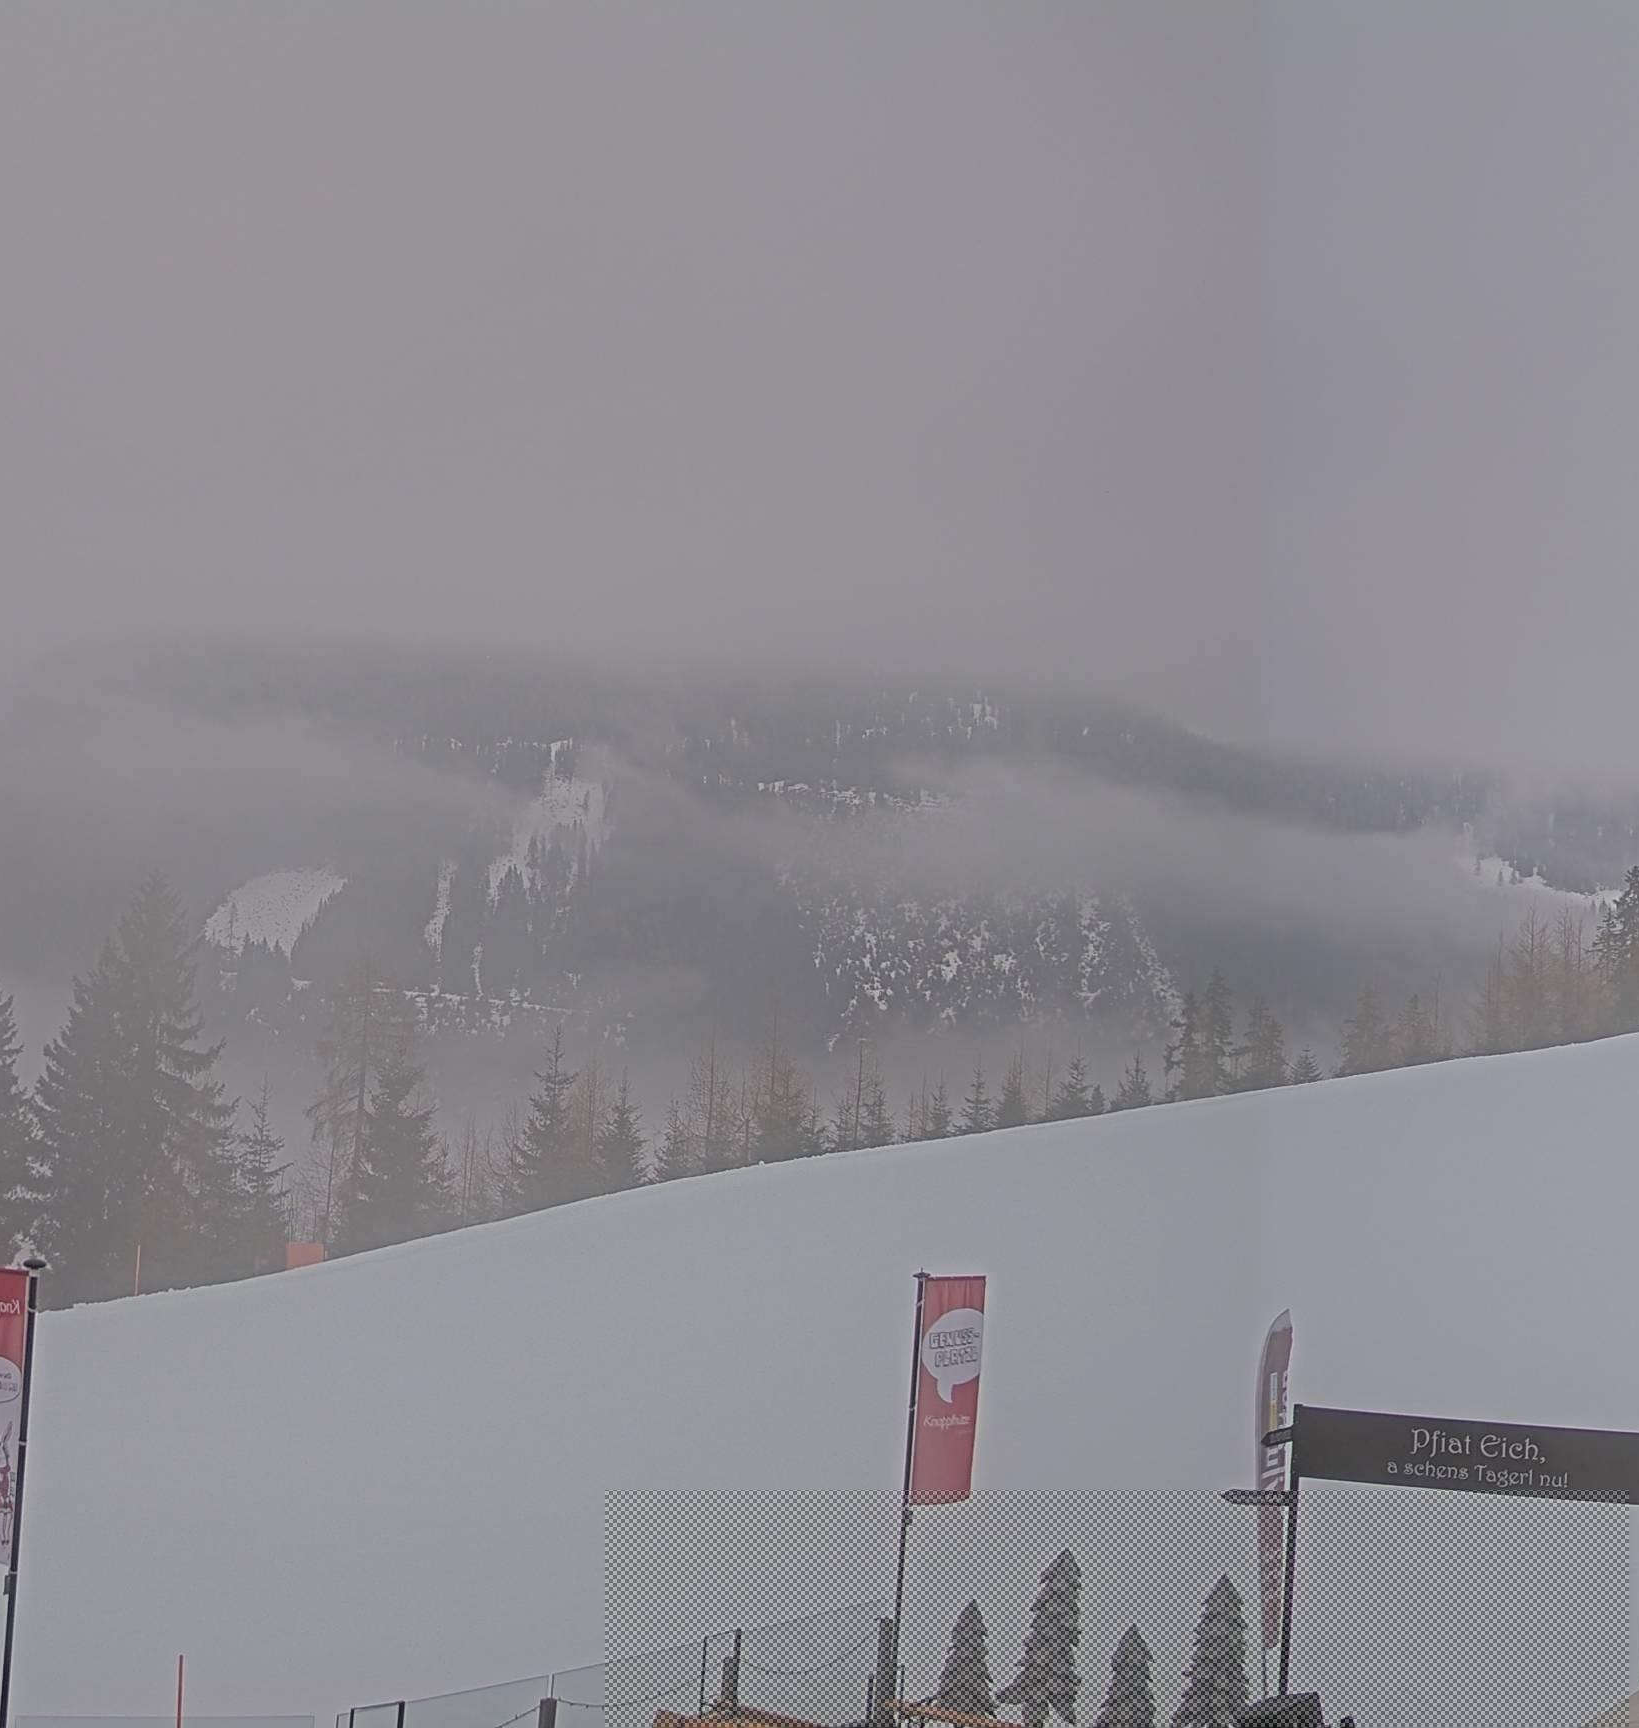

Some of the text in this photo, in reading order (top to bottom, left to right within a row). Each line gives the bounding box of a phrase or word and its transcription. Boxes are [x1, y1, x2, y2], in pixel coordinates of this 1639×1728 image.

[1410, 1428, 1547, 1464] Pfiat Eich,
[1387, 1461, 1569, 1488] a schens Tagerl nu!
